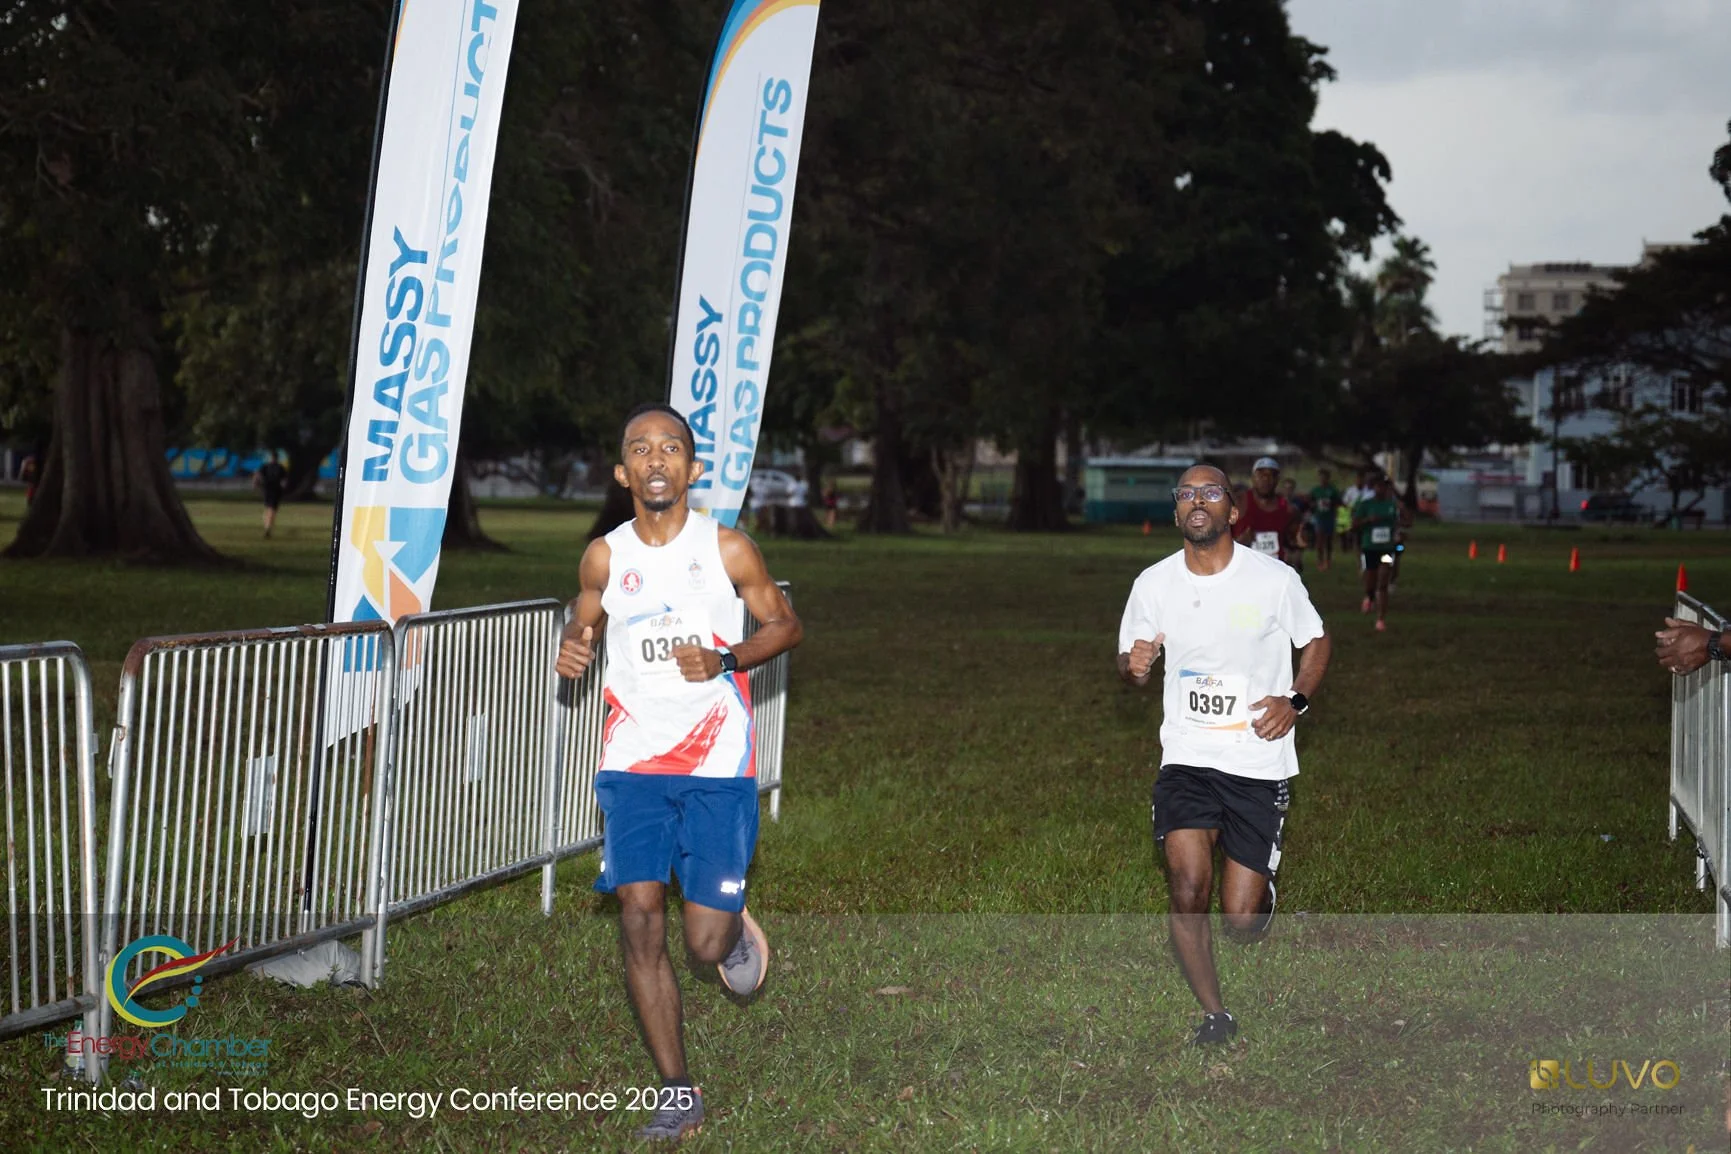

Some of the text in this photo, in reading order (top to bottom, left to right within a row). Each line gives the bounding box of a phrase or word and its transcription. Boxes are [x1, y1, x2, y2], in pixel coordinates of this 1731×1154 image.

[362, 224, 428, 481] MASSY
[720, 76, 793, 490] GAS PRODUCTS
[400, 338, 450, 484] GAS
[688, 294, 724, 490] MASSY
[1189, 690, 1237, 716] 0397
